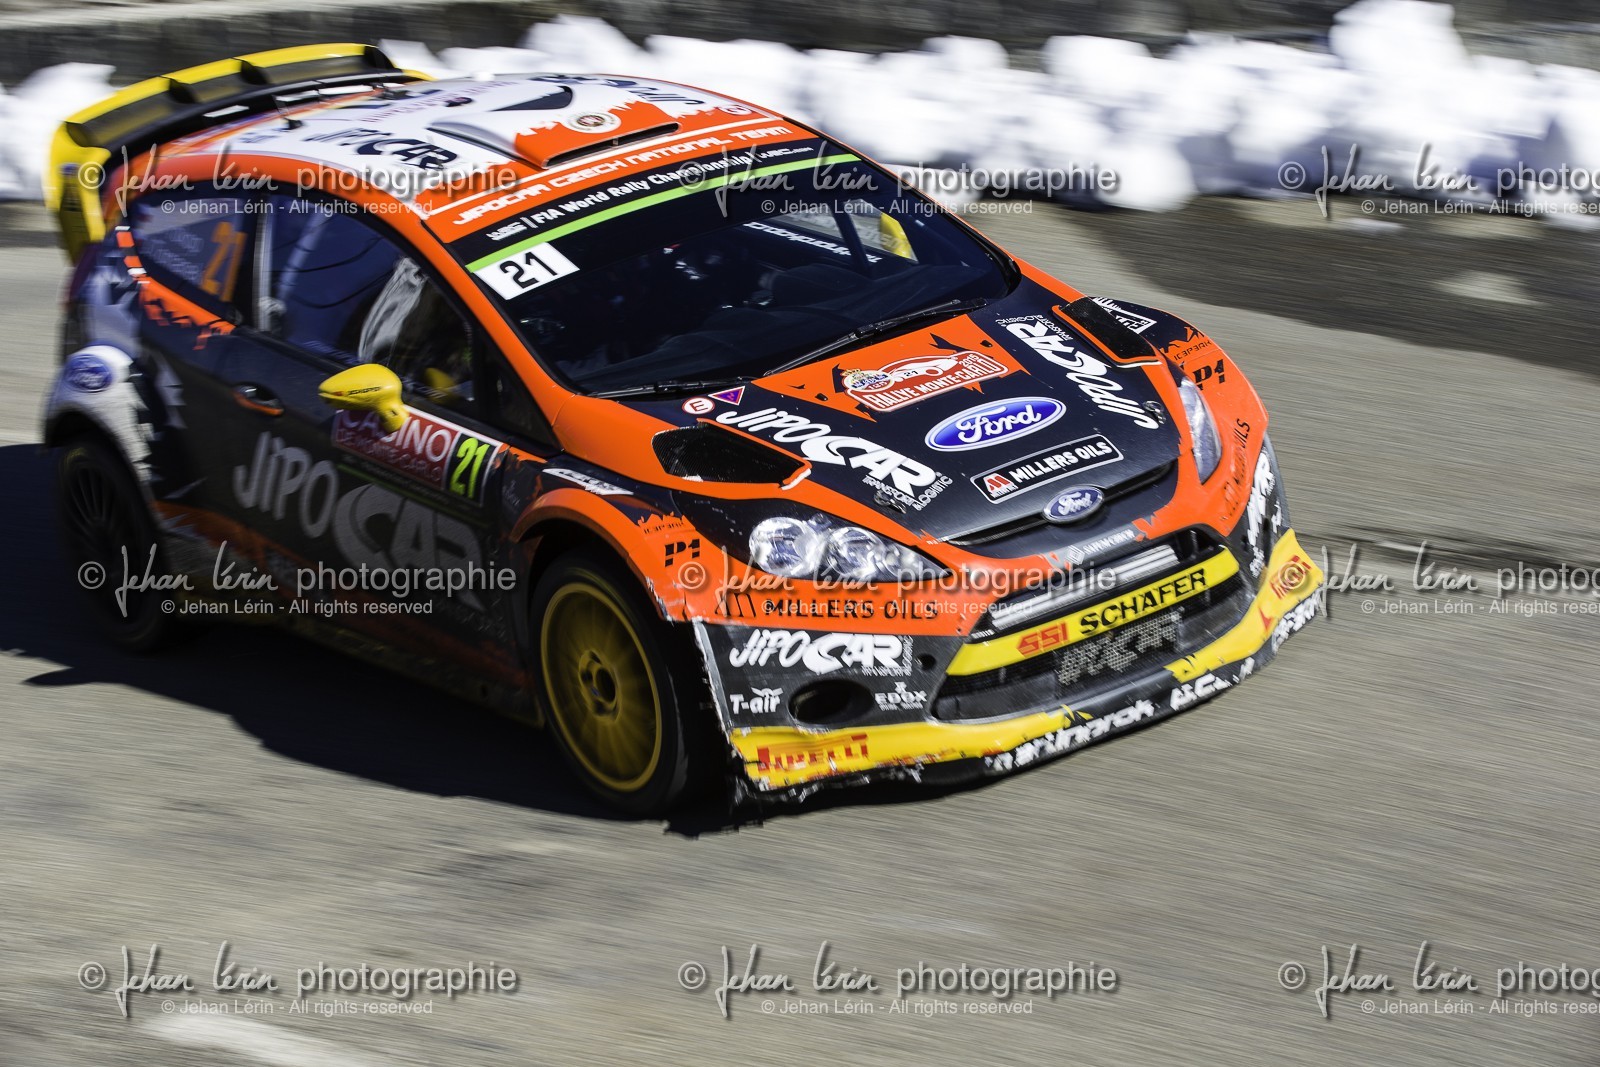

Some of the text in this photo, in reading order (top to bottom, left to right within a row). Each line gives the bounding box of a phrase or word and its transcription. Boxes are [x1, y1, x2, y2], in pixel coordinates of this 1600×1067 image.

[548, 159, 628, 189] CZECH
[624, 137, 733, 166] NATIONAL
[729, 126, 792, 141] TEAM
[530, 154, 753, 224] FIA World Rally Championship
[500, 251, 557, 289] 21
[958, 353, 981, 368] 2015
[862, 385, 917, 408] RALLYE
[955, 401, 1043, 444] Ford
[451, 437, 490, 499] 21
[1008, 441, 1113, 483] MILLERS OILS
[1057, 491, 1093, 516] Ford
[665, 538, 700, 568] P1
[765, 598, 939, 620] MILLERS OILS
[730, 690, 781, 714] T-air
[875, 690, 927, 704] EDOX
